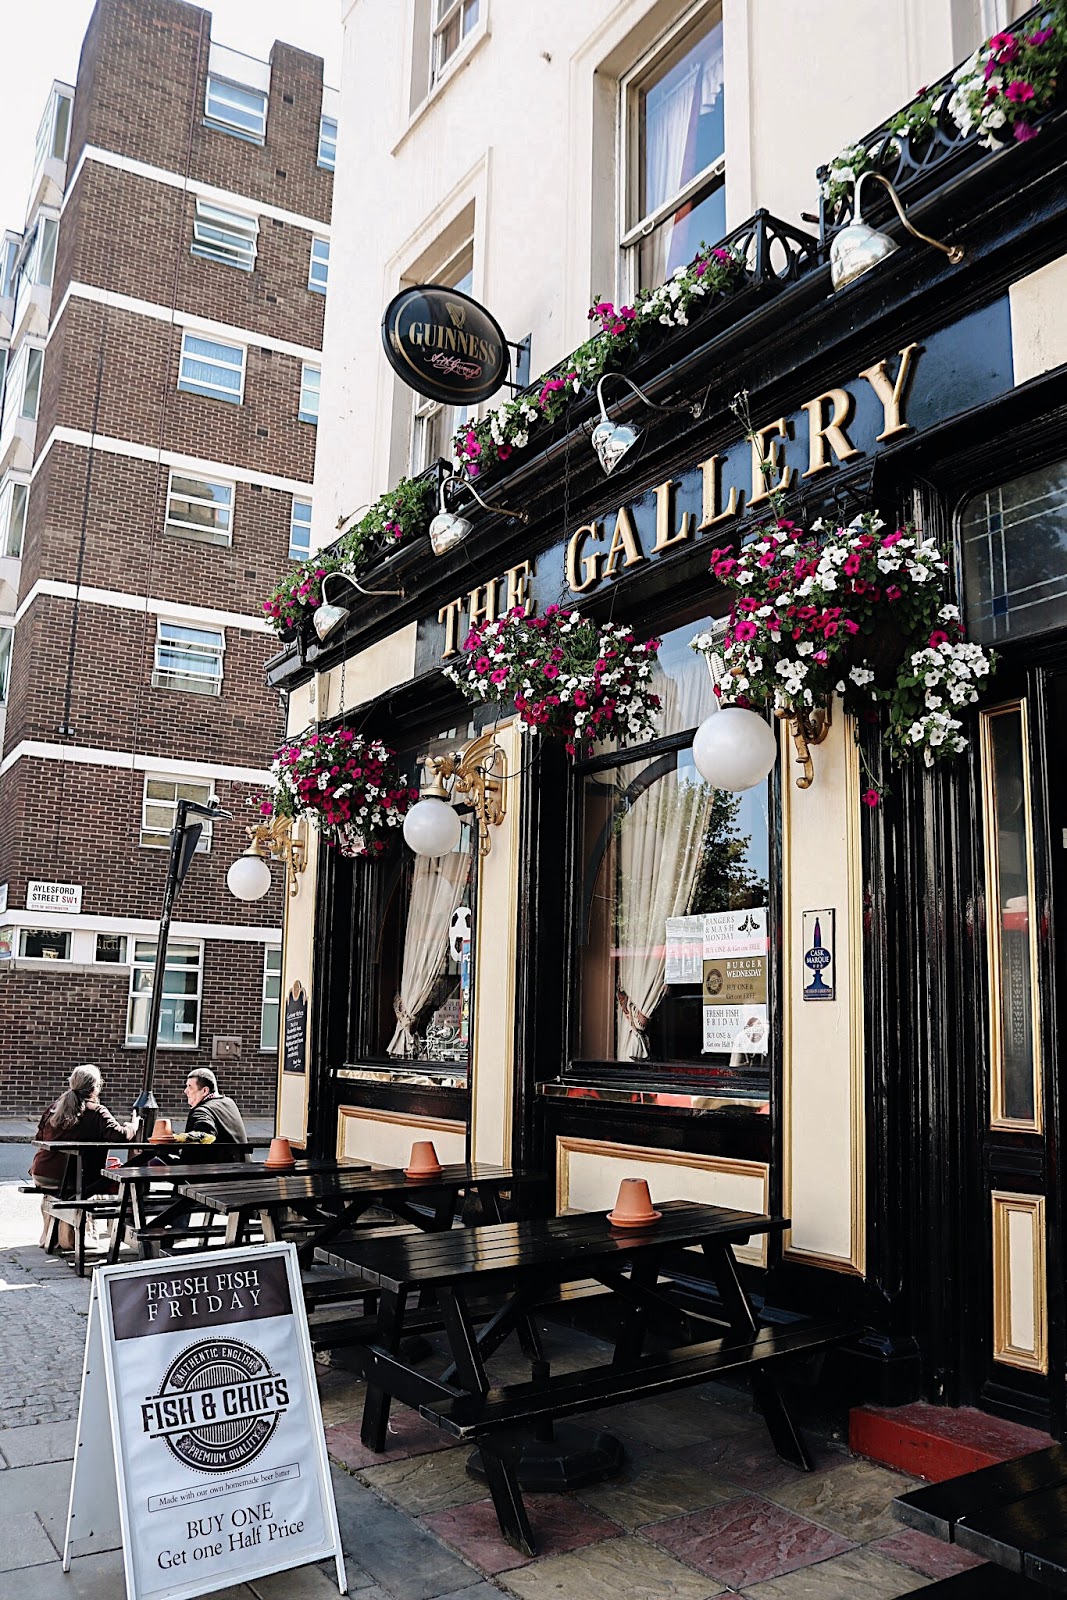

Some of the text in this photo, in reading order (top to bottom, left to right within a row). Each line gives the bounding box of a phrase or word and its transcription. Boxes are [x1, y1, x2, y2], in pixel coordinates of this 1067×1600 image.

[409, 322, 496, 366] GUINNESS
[438, 342, 918, 659] THE GALLERY
[32, 893, 59, 902] STREET
[33, 885, 75, 895] AYLESFORD
[706, 932, 734, 942] MONDAY
[711, 924, 734, 933] MASH
[806, 956, 830, 964] MARQUE
[810, 949, 824, 957] CASK
[726, 960, 762, 969] BURGER
[726, 968, 762, 978] WEDNESDAY
[706, 1009, 740, 1018] FRESH FISH
[706, 1018, 740, 1026] FRIDAY
[146, 1269, 260, 1301] FRESH FISH
[147, 1289, 262, 1322] FRIDAY
[176, 1347, 254, 1382] AUTHENTIC ENGLISH
[141, 1378, 290, 1433] FISH & CHIPS
[188, 1431, 260, 1464] PREMIUM QUALITY
[159, 1469, 290, 1506] Made with our own homemade beer batter
[186, 1501, 274, 1540] BUY ONE
[157, 1519, 305, 1570] Get one Half Price
